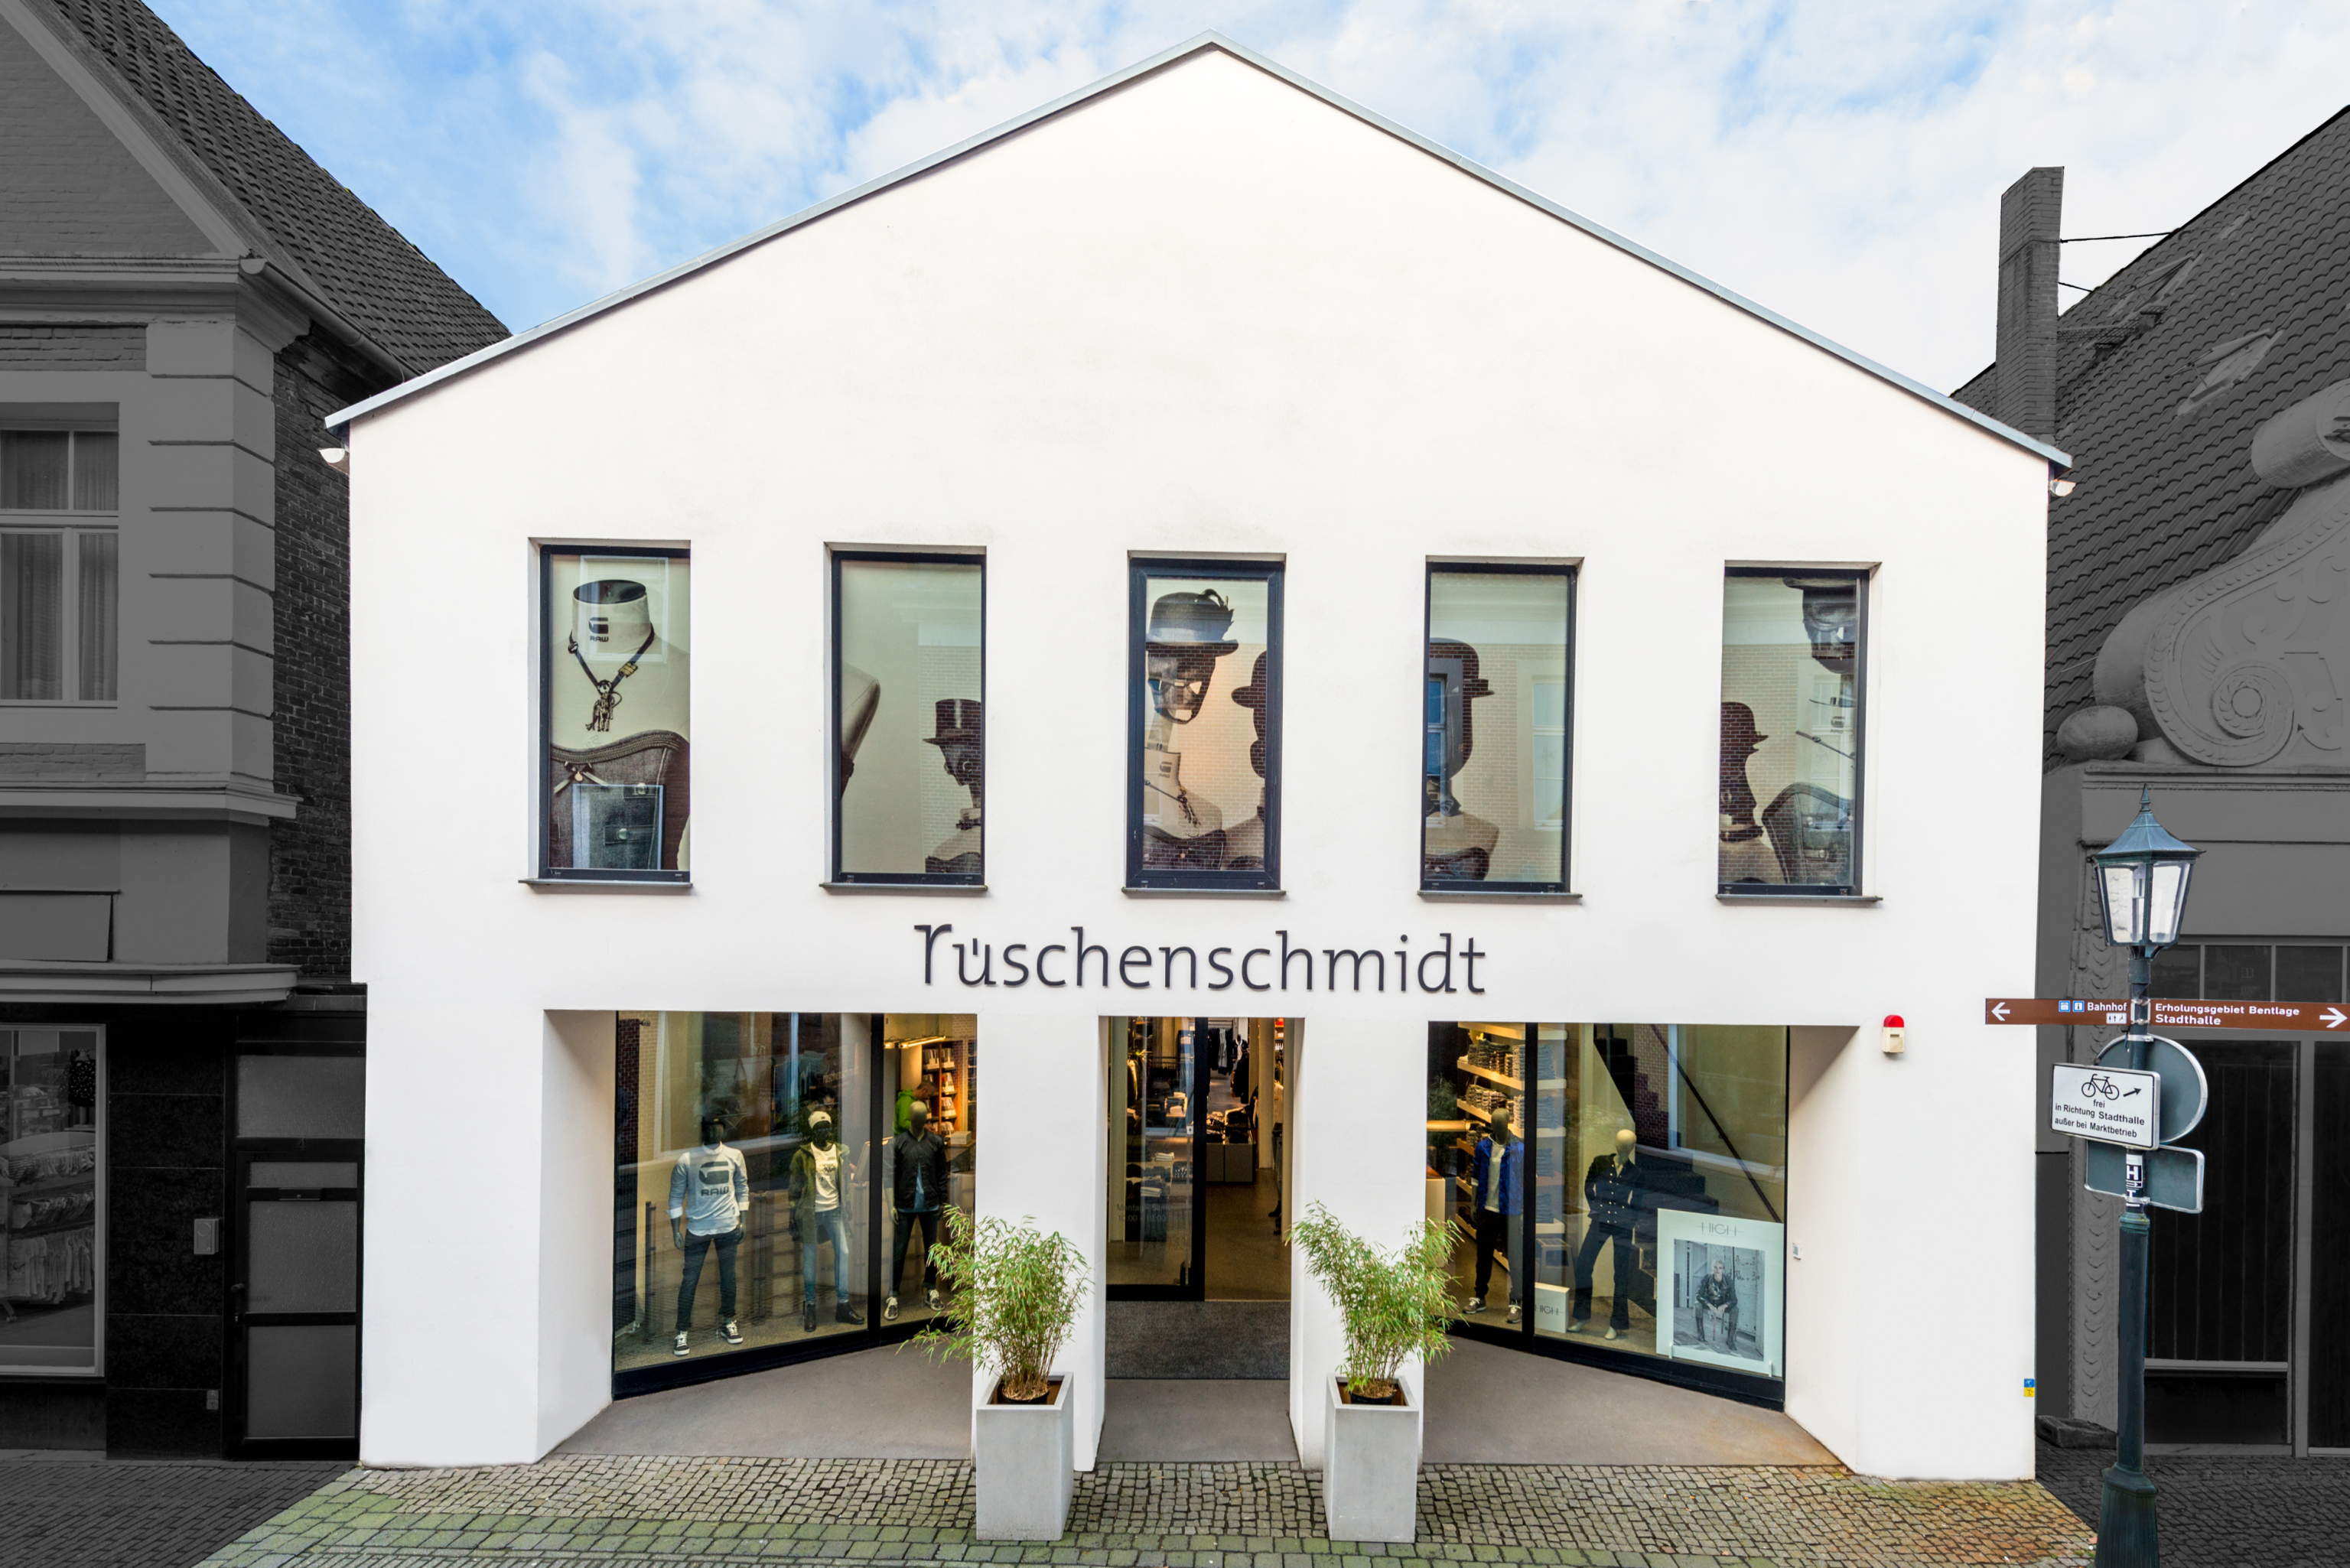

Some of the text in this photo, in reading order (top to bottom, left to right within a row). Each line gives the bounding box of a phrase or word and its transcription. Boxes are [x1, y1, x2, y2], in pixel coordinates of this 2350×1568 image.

[2087, 1002, 2127, 1011] Bahnhof
[2155, 1003, 2300, 1017] Erholungsgebiet Bentlage
[2155, 1014, 2221, 1026] Stadthalle
[2093, 1099, 2105, 1108] frei
[2063, 1104, 2095, 1118] Richtung
[2098, 1111, 2145, 1126] Stadthalle
[2055, 1117, 2137, 1138] außer bei Marktbetrieb
[297, 1137, 306, 1151] 4
[2127, 1165, 2139, 1180] H
[701, 1186, 729, 1196] RAW
[1116, 1203, 1144, 1212] Montag
[1701, 1222, 1736, 1236] HIGH
